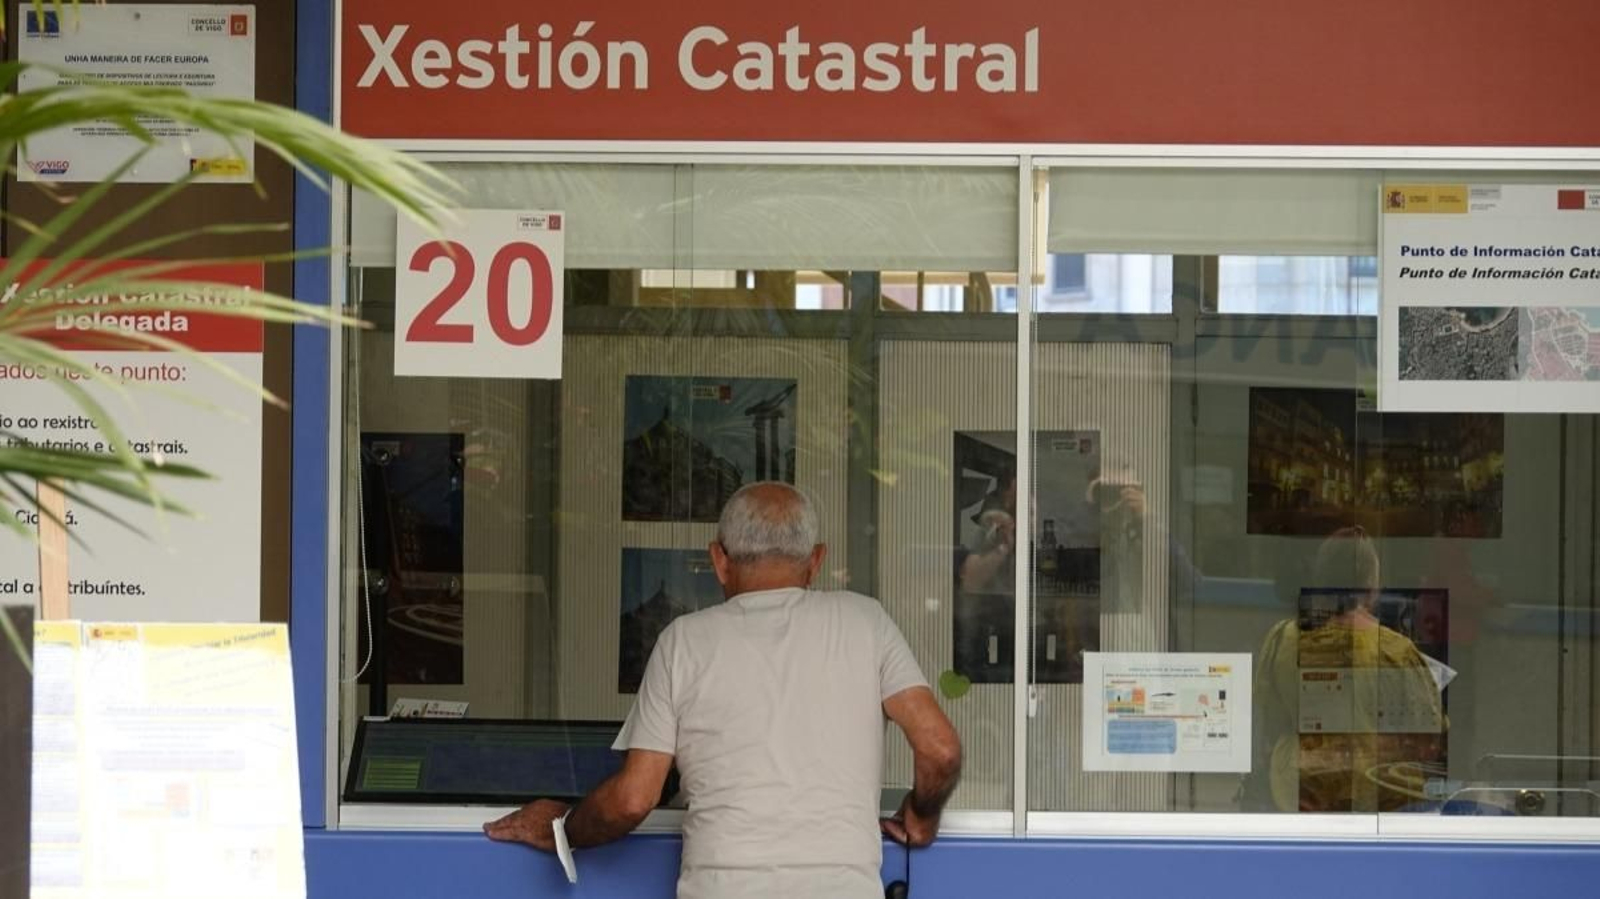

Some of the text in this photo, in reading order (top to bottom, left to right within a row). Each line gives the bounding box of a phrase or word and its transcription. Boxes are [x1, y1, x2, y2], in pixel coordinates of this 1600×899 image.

[64, 55, 209, 64] UNHA MANEIRA DE FACER EUROPA
[356, 21, 1040, 92] Xestión Catastral
[46, 161, 70, 169] VIGO
[1400, 246, 1445, 257] Punto
[1450, 246, 1468, 257] de
[1474, 245, 1565, 257] Información
[1399, 267, 1444, 279] Punto
[1448, 267, 1467, 279] de
[1472, 266, 1564, 279] Información
[405, 240, 553, 346] 20
[55, 311, 189, 335] Delegada
[121, 363, 187, 384] punto:
[18, 417, 38, 428] ao
[94, 440, 104, 451] e
[109, 440, 188, 454] ctastrais.
[23, 583, 33, 594] a
[39, 580, 146, 597] tribuíntes.
